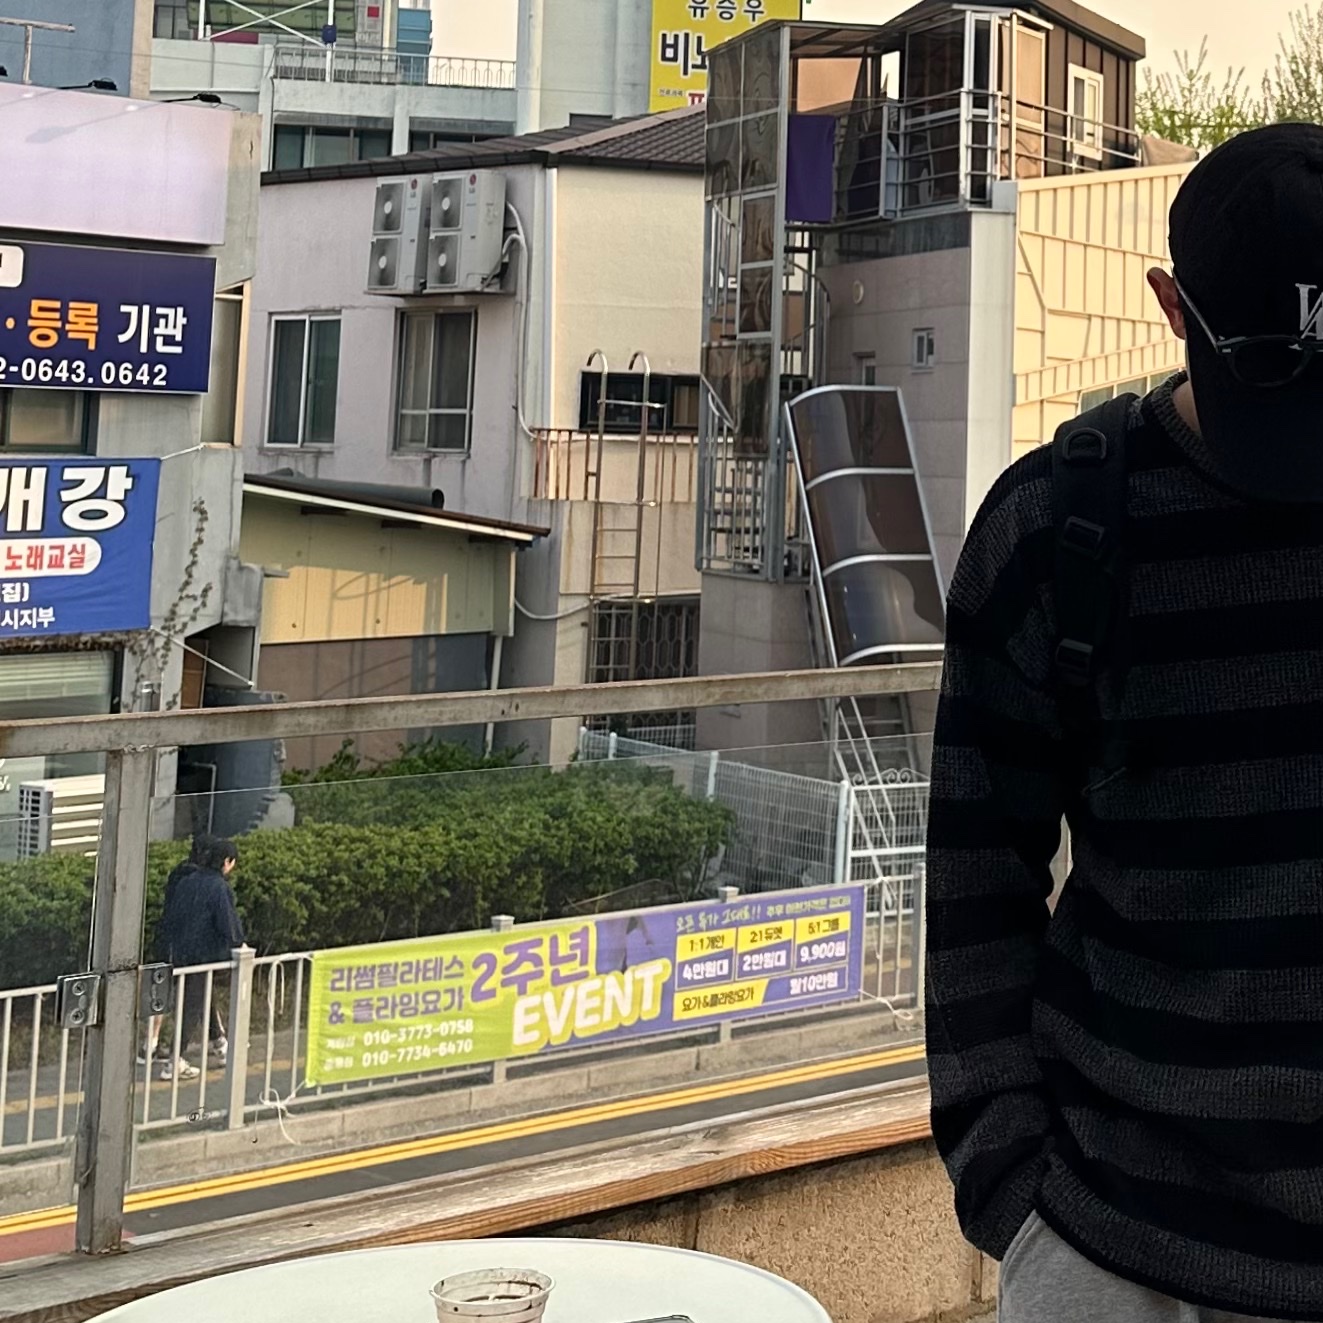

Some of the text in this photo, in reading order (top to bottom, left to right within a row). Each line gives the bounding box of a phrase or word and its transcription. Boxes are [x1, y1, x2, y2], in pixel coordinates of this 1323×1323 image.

[117, 304, 187, 354] 기관
[4, 543, 86, 571] 노래교실
[471, 925, 590, 1003] 2주년
[512, 963, 666, 1047] EVENT
